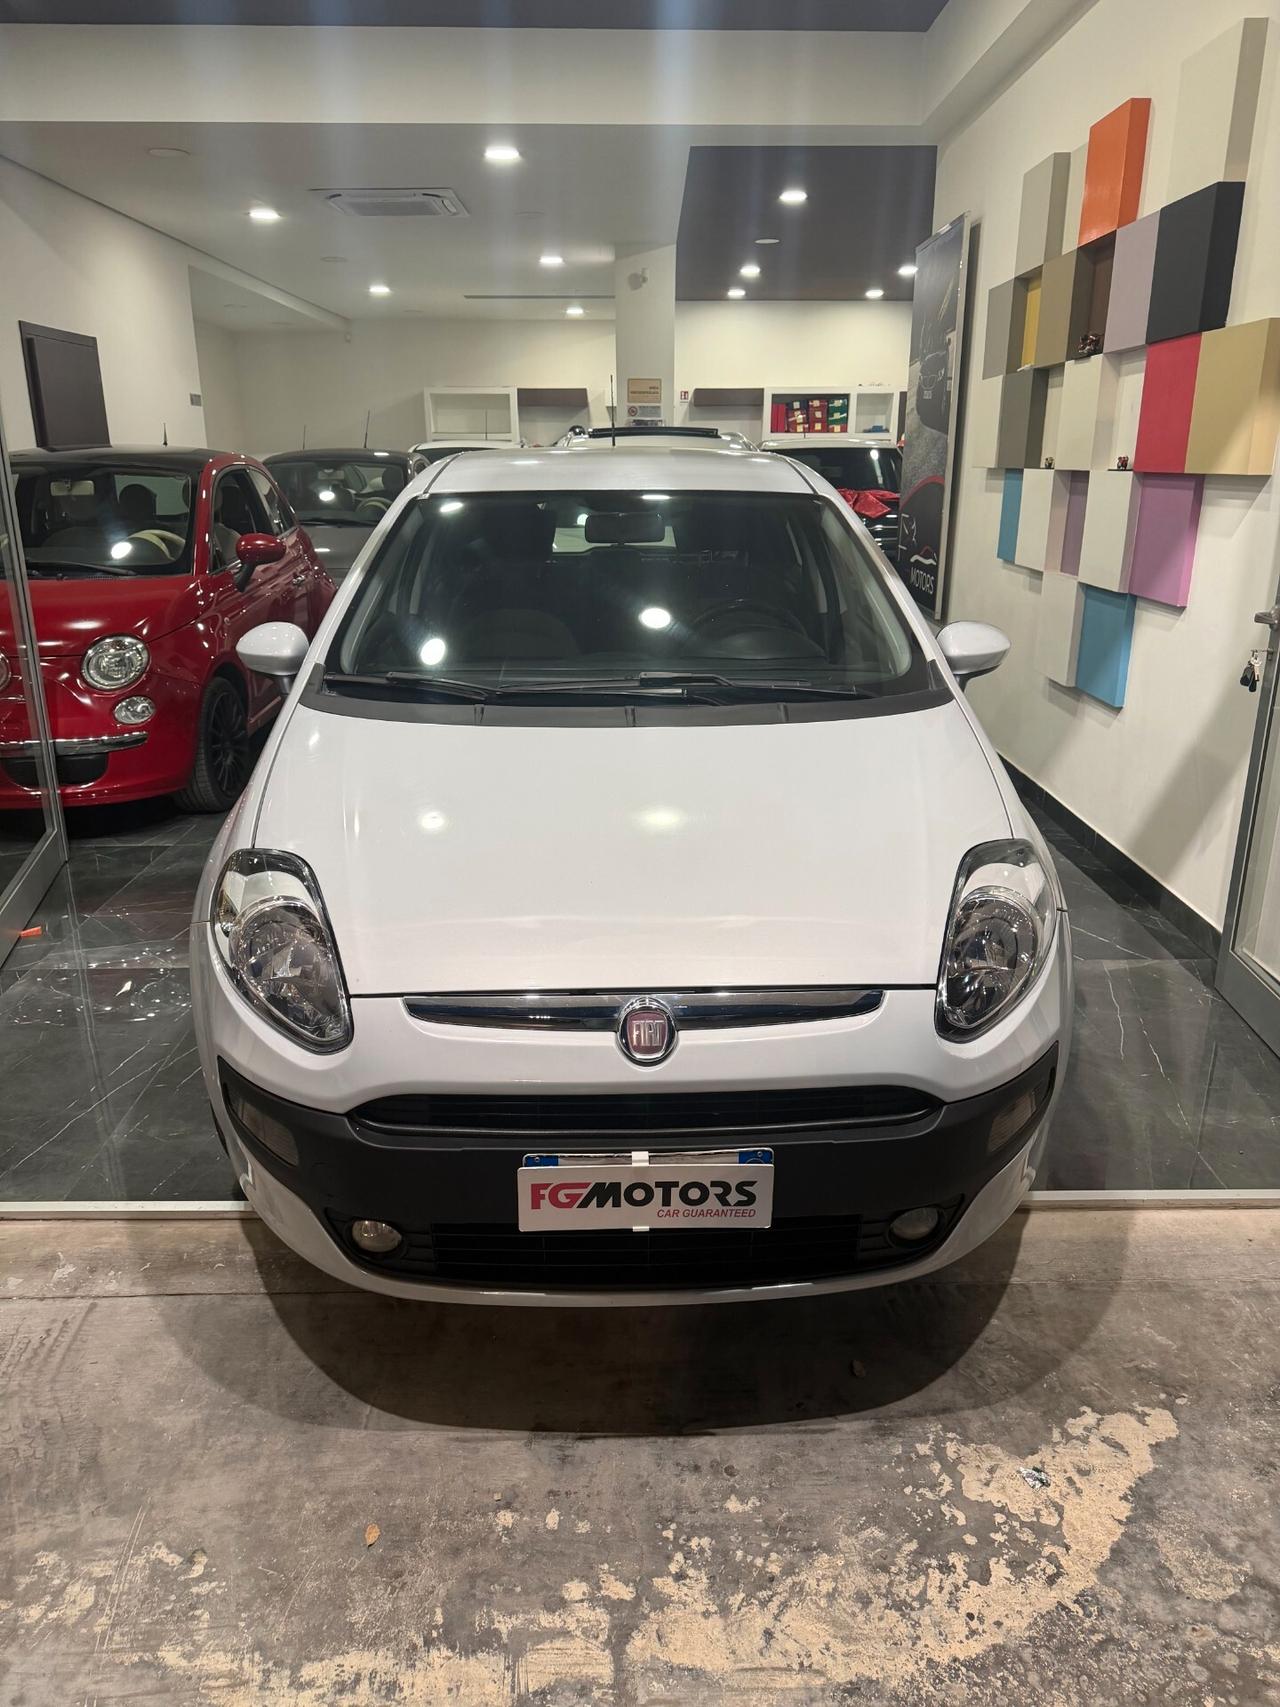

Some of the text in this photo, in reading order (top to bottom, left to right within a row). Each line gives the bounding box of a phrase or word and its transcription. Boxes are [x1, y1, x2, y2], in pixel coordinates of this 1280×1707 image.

[910, 567, 935, 594] MOTORS
[632, 1019, 664, 1046] FIAT
[656, 1208, 756, 1218] CAR GUARANTEED
